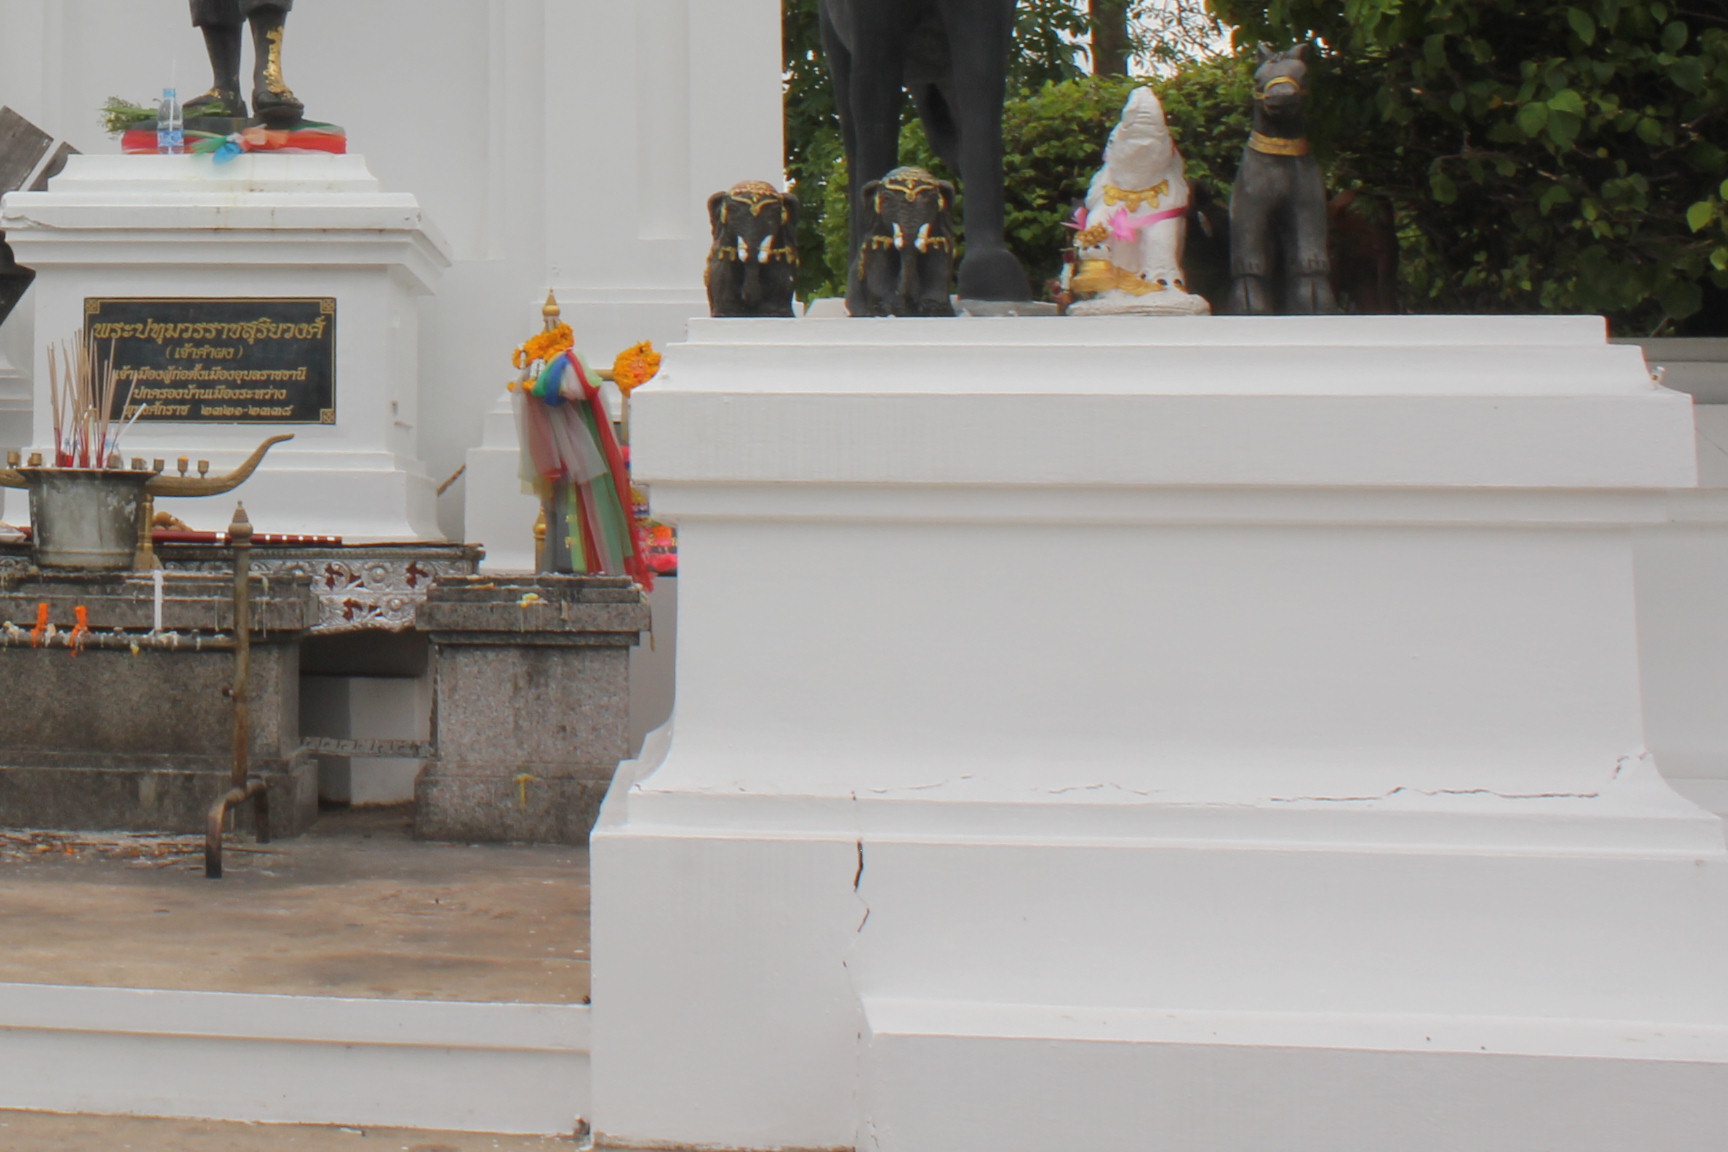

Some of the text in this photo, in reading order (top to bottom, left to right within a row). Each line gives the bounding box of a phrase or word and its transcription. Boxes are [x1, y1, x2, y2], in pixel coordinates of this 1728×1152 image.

[114, 363, 308, 384] เจ้ามืองผู้ก่อตั้งเมืองอุบลราชธานี
